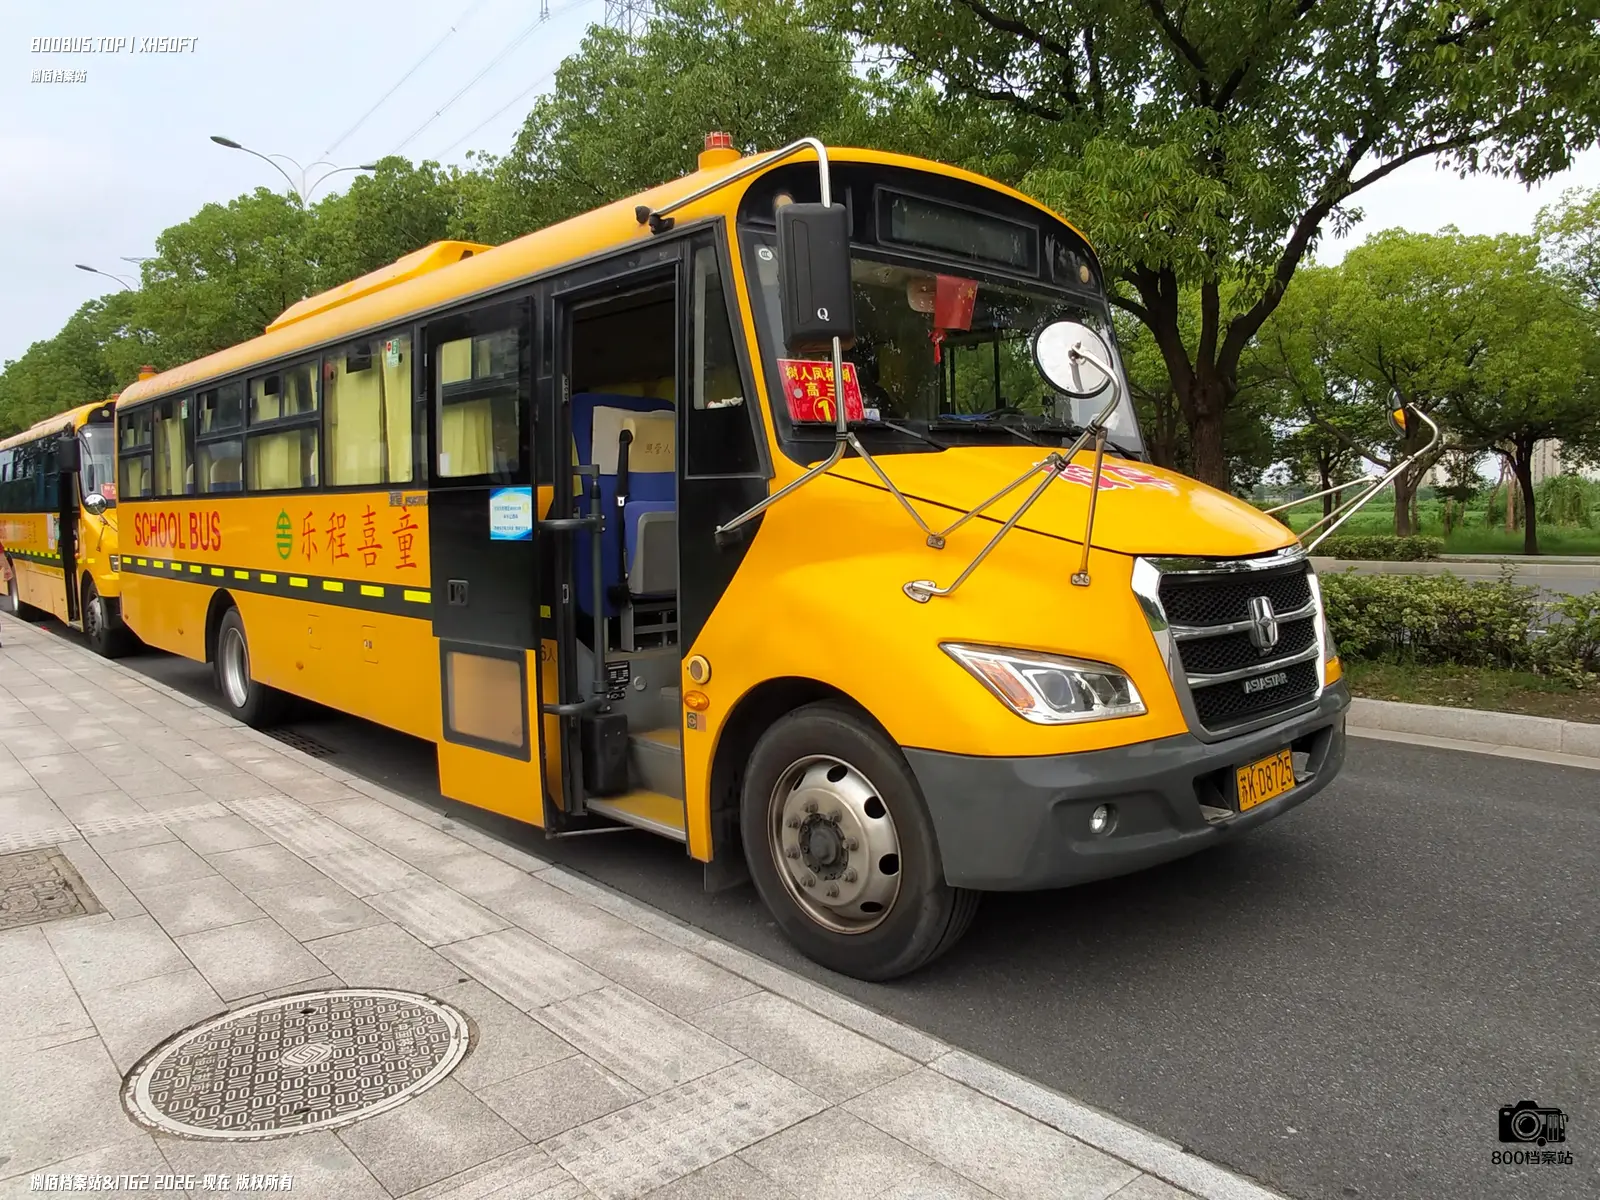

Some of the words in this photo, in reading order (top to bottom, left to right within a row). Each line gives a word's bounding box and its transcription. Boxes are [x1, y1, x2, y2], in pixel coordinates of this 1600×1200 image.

[817, 307, 830, 322] Q
[817, 400, 832, 422] 1
[134, 511, 186, 549] SCHOOL
[188, 510, 222, 551] BUS
[301, 504, 419, 569] 乐程喜童
[1245, 672, 1288, 694] ASIASTAR
